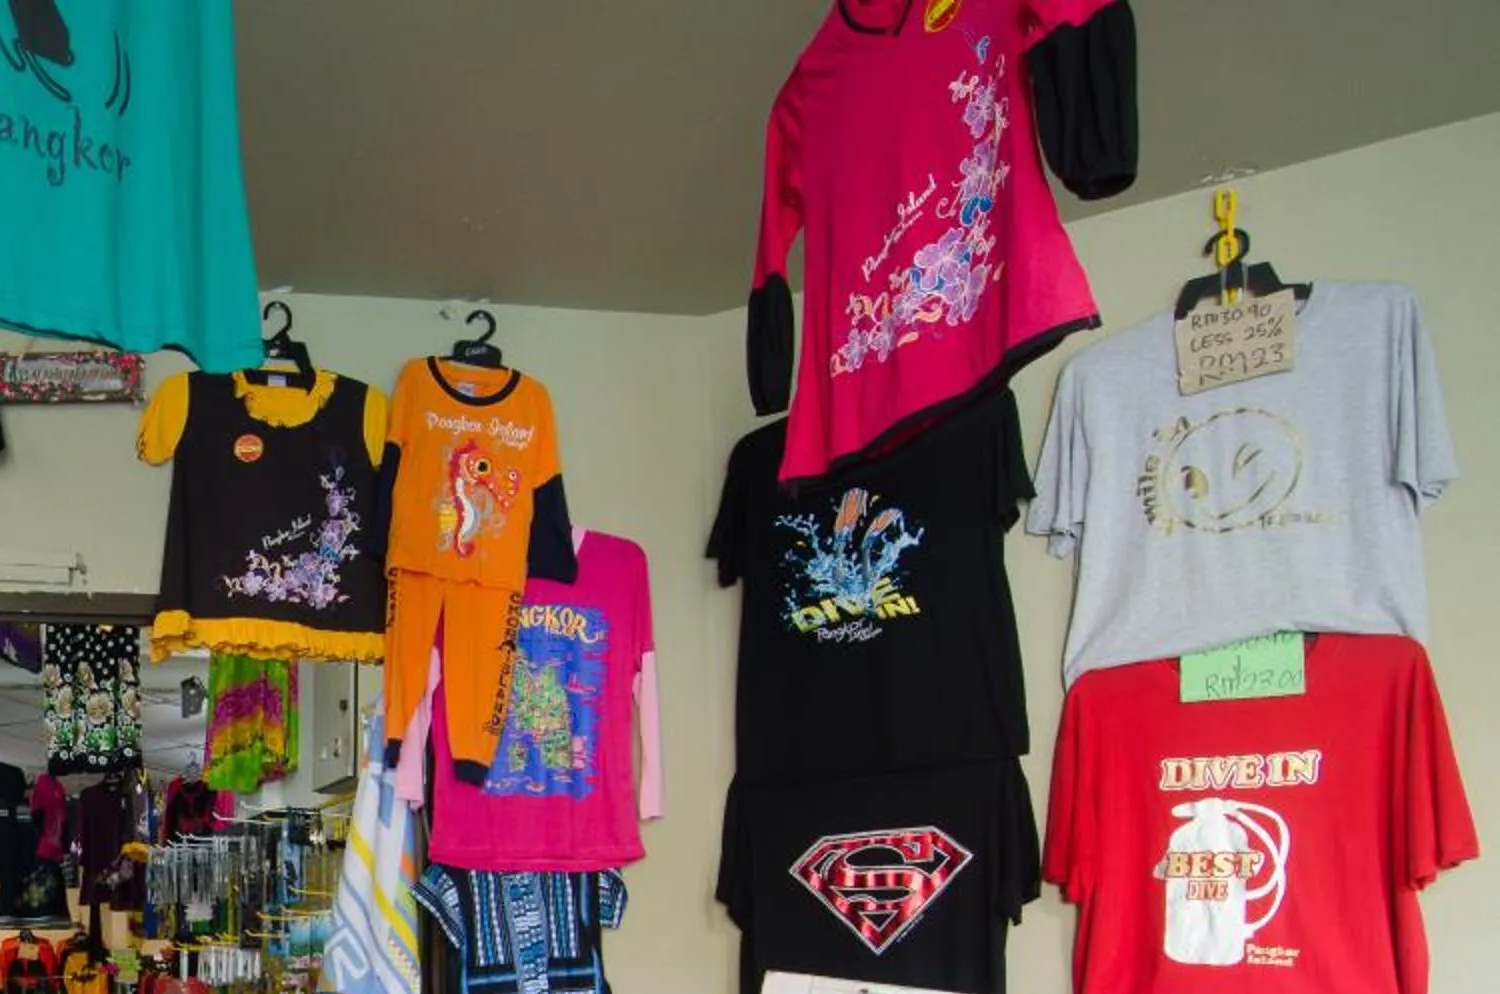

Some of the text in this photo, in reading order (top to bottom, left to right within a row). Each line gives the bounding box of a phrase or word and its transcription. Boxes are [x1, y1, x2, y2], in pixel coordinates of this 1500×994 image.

[519, 605, 600, 643] NGKOR
[1159, 749, 1322, 791] DIVE IN
[1164, 851, 1262, 879] BEST
[1187, 879, 1229, 900] DIVE
